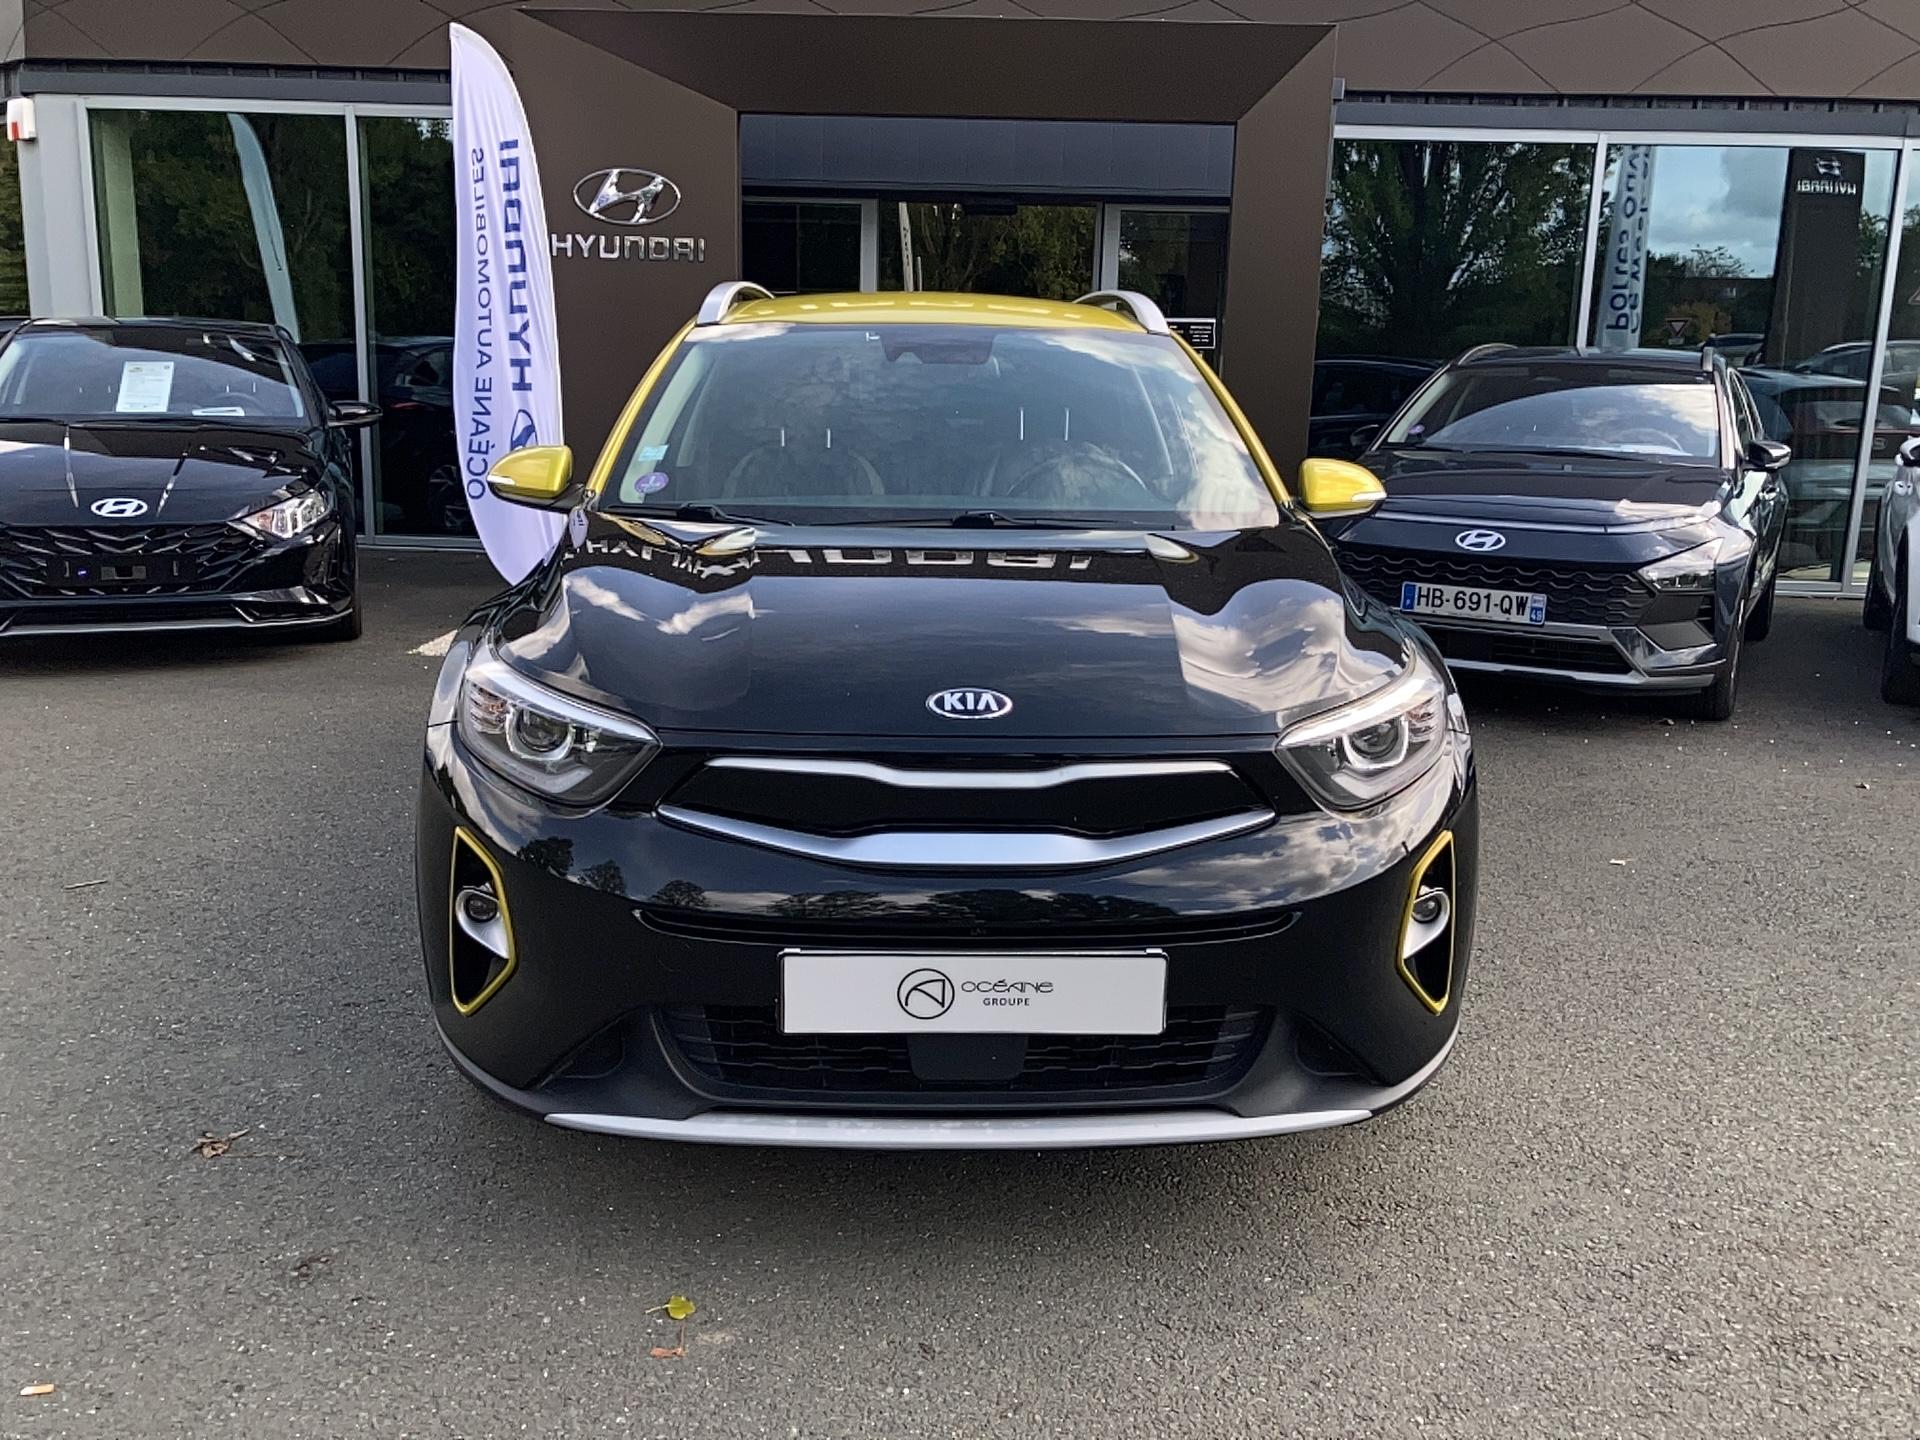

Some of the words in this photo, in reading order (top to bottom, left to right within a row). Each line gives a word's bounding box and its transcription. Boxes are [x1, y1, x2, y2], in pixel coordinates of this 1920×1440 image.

[551, 233, 705, 263] HYUNDAI
[1416, 586, 1529, 617] HB-691-QW
[944, 692, 999, 711] KIA
[961, 979, 1054, 994] OCÉANE
[983, 997, 1030, 1007] GROUPE
